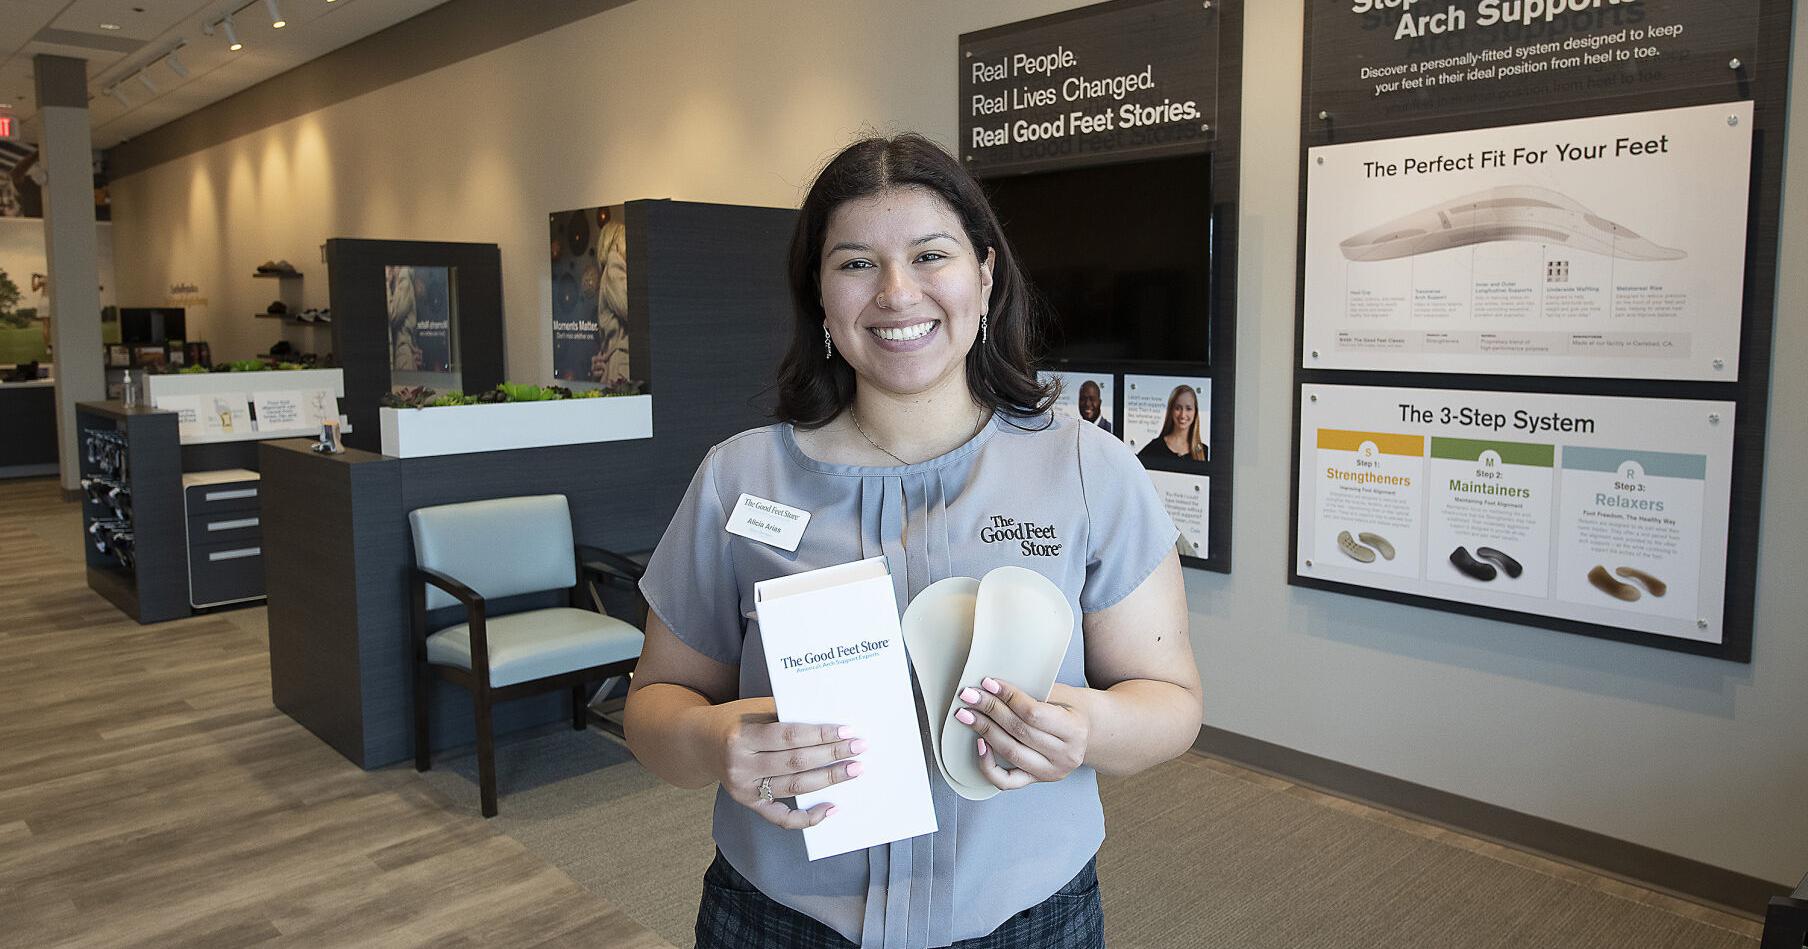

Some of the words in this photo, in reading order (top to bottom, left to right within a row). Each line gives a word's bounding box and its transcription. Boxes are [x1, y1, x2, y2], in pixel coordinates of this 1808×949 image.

[1394, 5, 1465, 40] Arch
[1360, 64, 1408, 80] Discover
[1410, 64, 1418, 73] a
[1420, 47, 1512, 73] personally-fitted
[1515, 42, 1560, 59] system
[1563, 30, 1626, 49] designed
[1630, 28, 1644, 41] to
[1648, 24, 1683, 38] keep
[972, 57, 1008, 84] Real
[1013, 46, 1077, 77] People.
[1375, 82, 1399, 96] your
[1401, 77, 1423, 90] feet
[1425, 74, 1436, 87] in
[1439, 71, 1464, 85] their
[1467, 65, 1495, 81] ideal
[1498, 61, 1547, 80] position
[1551, 56, 1580, 70] from
[1584, 50, 1612, 65] heel
[1616, 49, 1630, 61] to
[1634, 46, 1660, 59] toe.
[972, 90, 1008, 116] Real
[1013, 86, 1057, 110] Lives
[1062, 64, 1155, 101] Changed.
[972, 122, 1009, 148] Real
[1013, 114, 1065, 143] Good
[1069, 108, 1114, 135] Feet
[1118, 98, 1201, 129] Stories.
[1363, 162, 1397, 178] The
[1404, 152, 1474, 175] Perfect
[1481, 150, 1506, 169] Fit
[1513, 147, 1548, 166] For
[1556, 143, 1607, 162] Your
[1615, 135, 1669, 157] Feet
[553, 320, 578, 330] Moments
[1398, 404, 1433, 423] The
[1440, 407, 1506, 431] 3-Step
[1513, 410, 1595, 433] System
[1365, 448, 1371, 457] S
[1485, 458, 1494, 467] M
[1356, 460, 1372, 468] Step
[1626, 469, 1635, 479] R
[1326, 467, 1411, 487] Strengtheners
[1475, 470, 1494, 479] Step
[1449, 479, 1530, 499] Maintainers
[1614, 481, 1636, 491] Step
[1637, 483, 1646, 492] 3:
[755, 501, 772, 513] Good
[771, 506, 784, 518] Feet
[1595, 493, 1664, 512] Relaxers
[747, 518, 764, 528] Alicia
[765, 523, 782, 533] Arias
[990, 515, 1015, 528] The
[980, 522, 1025, 543] Good
[1024, 522, 1057, 539] Feet
[780, 656, 803, 669] The
[804, 647, 835, 664] Good
[837, 643, 861, 658] Feet
[860, 639, 889, 653] Store
